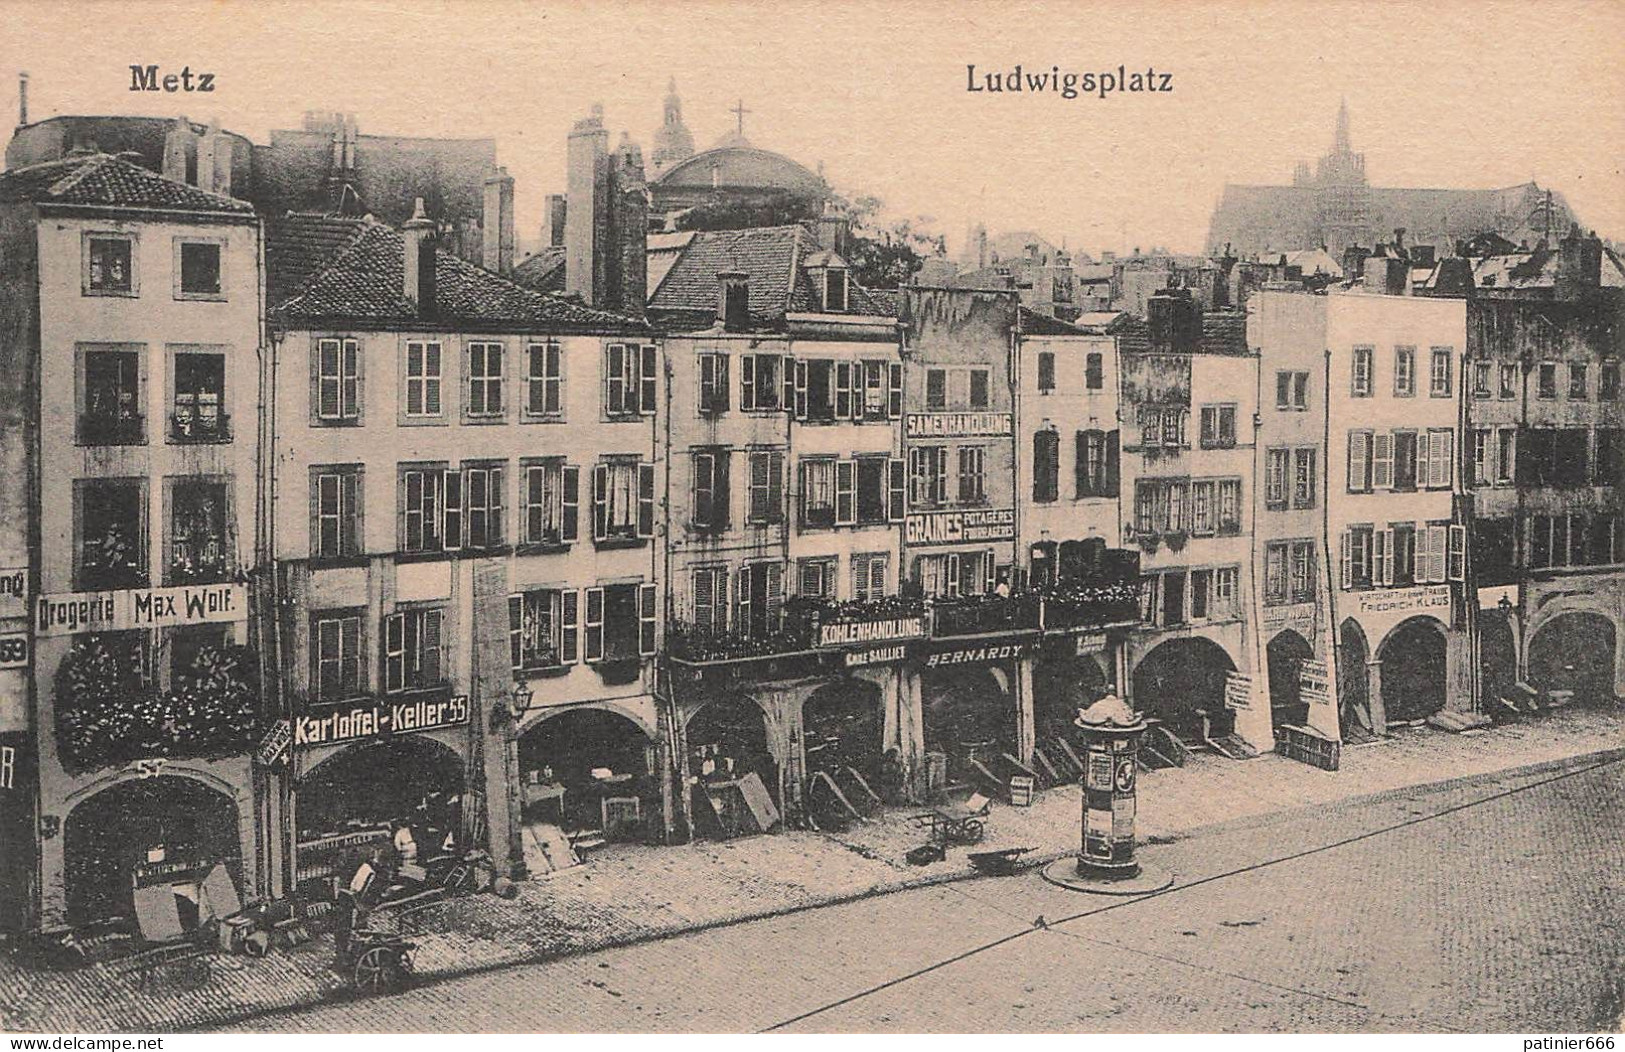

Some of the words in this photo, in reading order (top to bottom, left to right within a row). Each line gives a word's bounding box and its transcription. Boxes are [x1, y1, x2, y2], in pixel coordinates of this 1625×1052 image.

[907, 414, 1011, 435] SAMENHANDLUNG
[906, 513, 962, 543] GRAINES
[39, 597, 115, 631] Drogerie
[135, 592, 176, 623] Max
[1416, 596, 1449, 608] KLAUS
[926, 645, 1024, 669] BERNARDY
[449, 697, 466, 722] 55
[137, 758, 167, 779] 57
